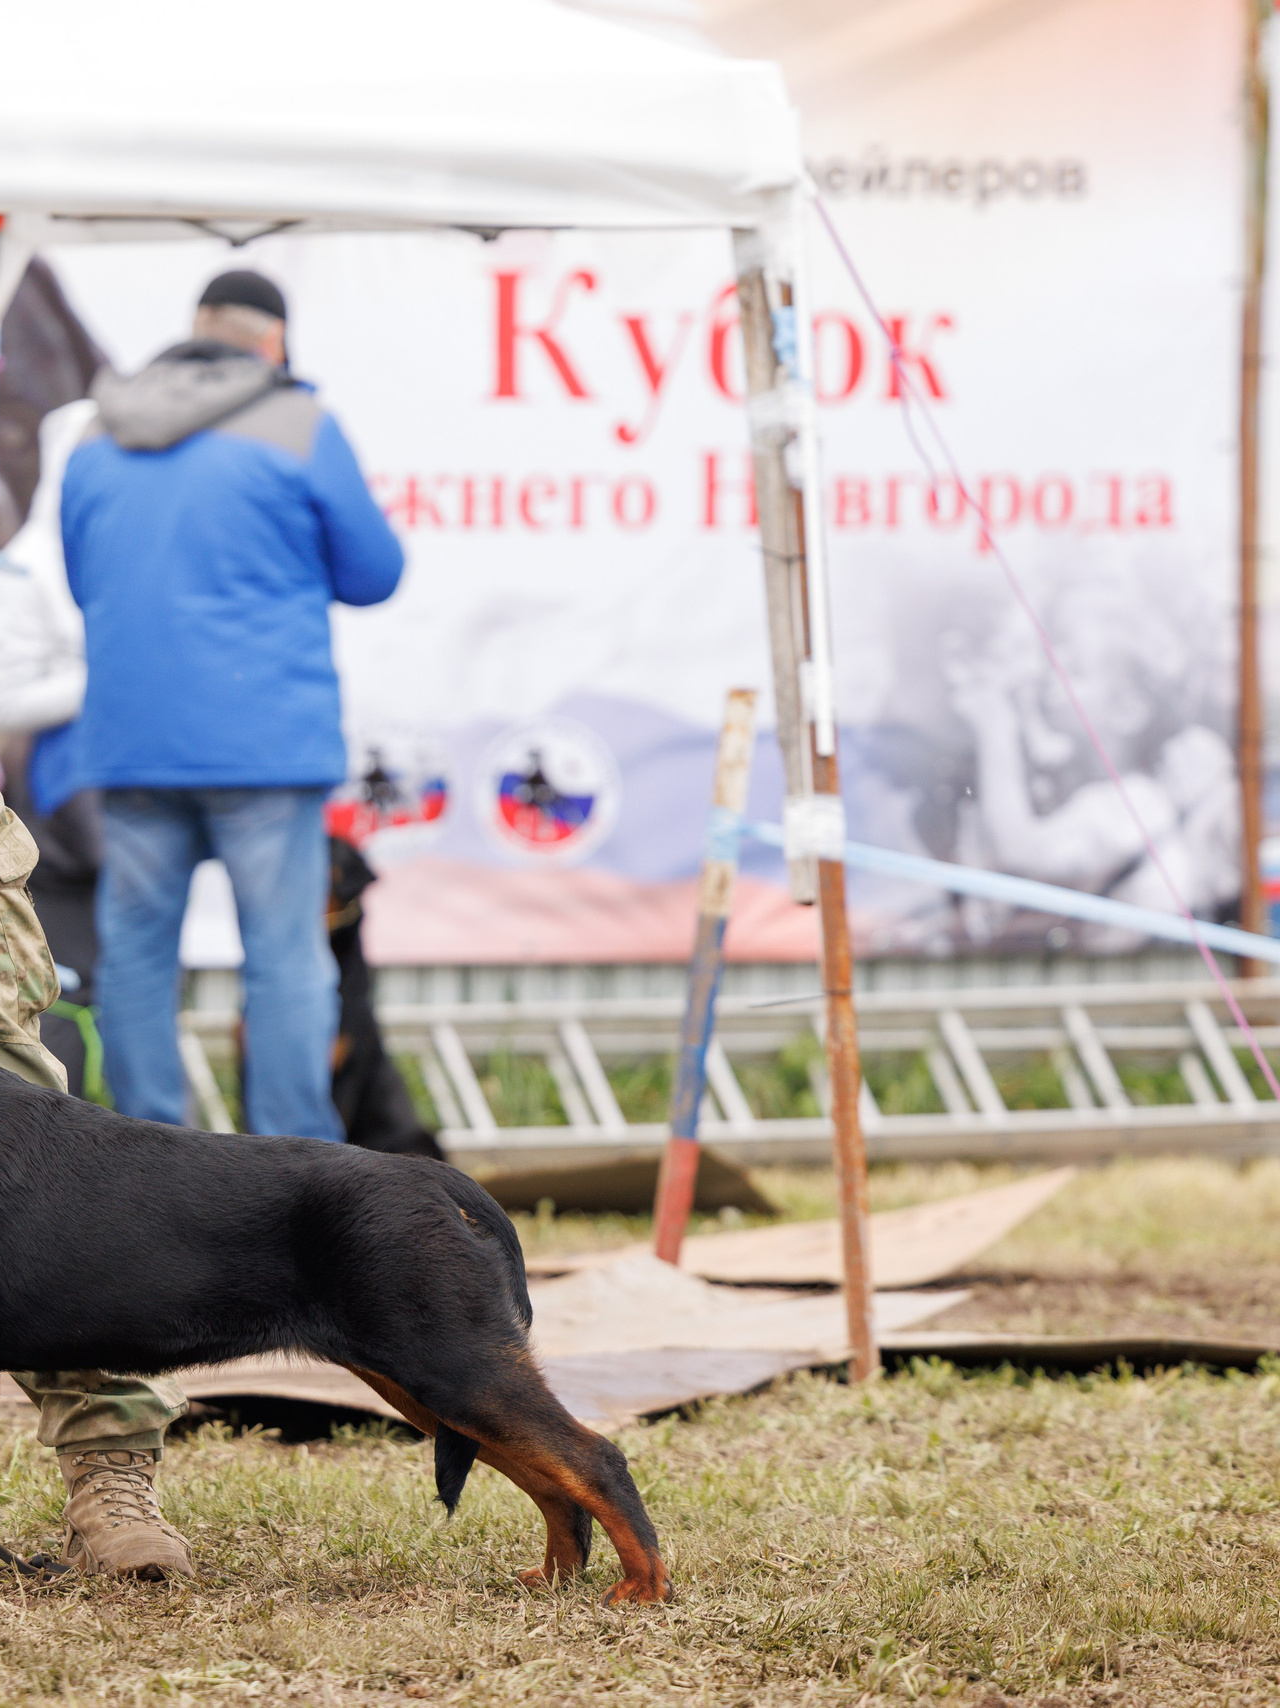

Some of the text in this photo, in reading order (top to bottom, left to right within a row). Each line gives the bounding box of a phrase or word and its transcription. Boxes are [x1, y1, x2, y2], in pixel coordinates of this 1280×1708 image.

[804, 142, 1088, 212] ейлеров
[370, 452, 1176, 554] жнего Нвгорода
